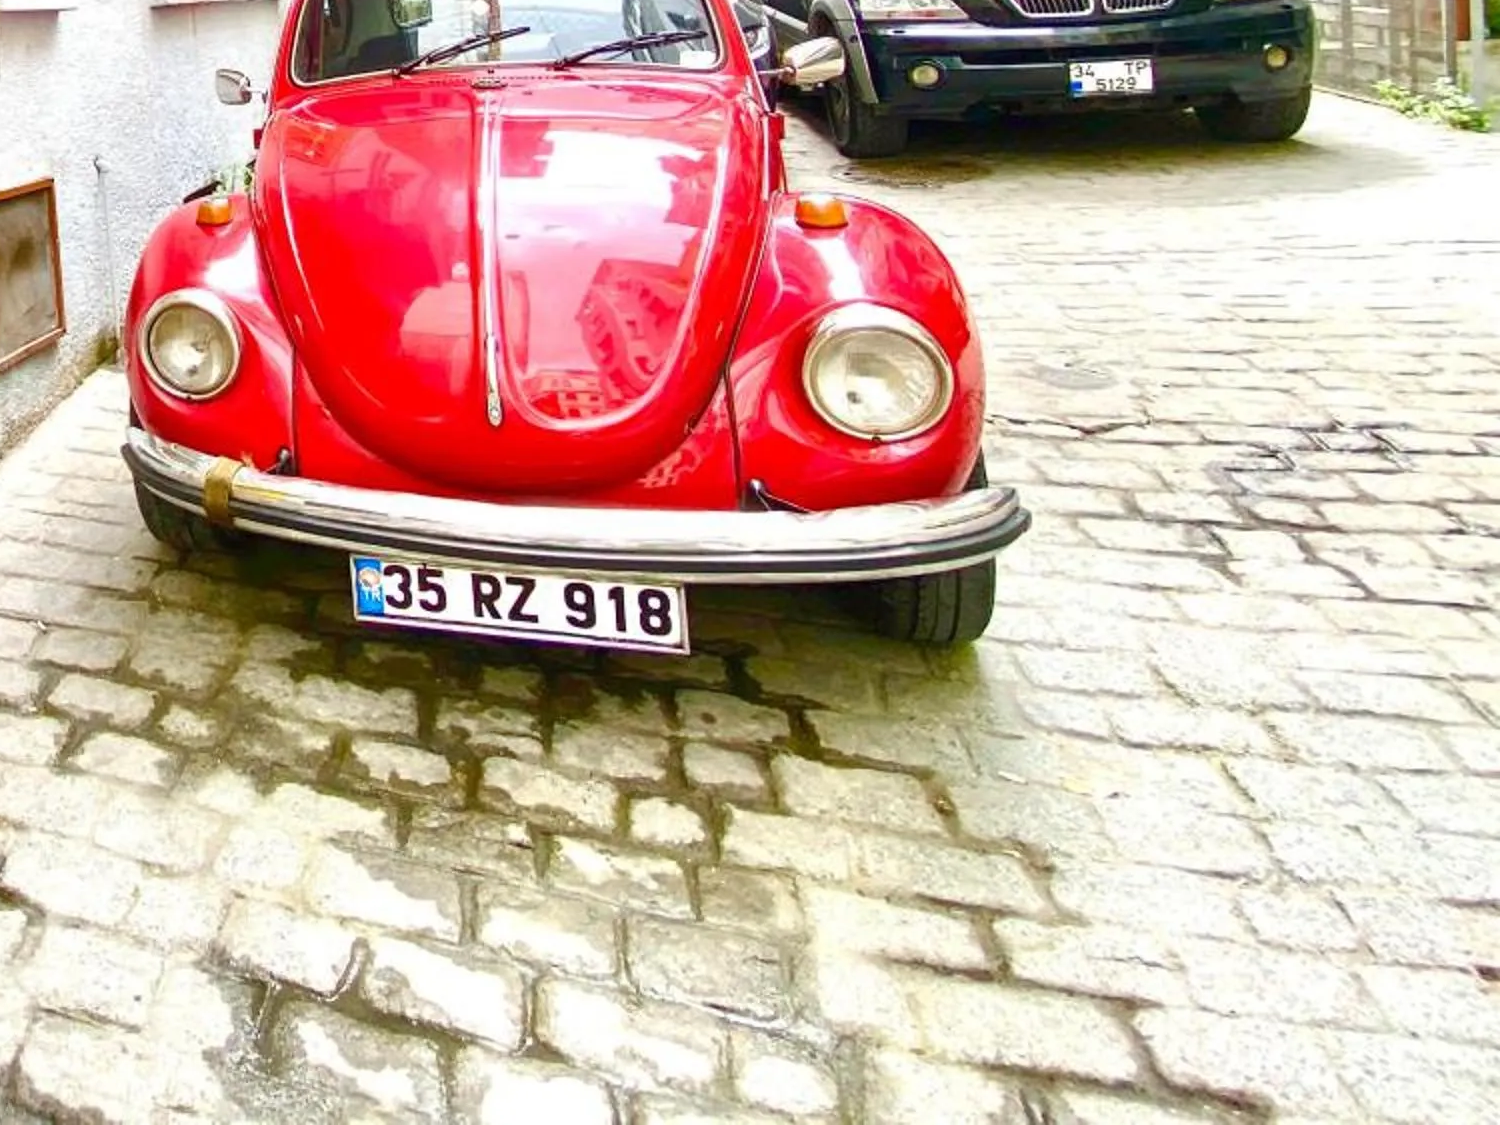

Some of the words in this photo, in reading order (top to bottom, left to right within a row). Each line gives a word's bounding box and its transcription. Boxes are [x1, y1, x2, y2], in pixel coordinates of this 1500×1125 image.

[1073, 64, 1095, 78] 34
[1123, 61, 1147, 76] TP
[1095, 77, 1137, 92] 5129
[383, 564, 448, 613] 35
[471, 573, 539, 623] RZ
[563, 582, 673, 636] 918
